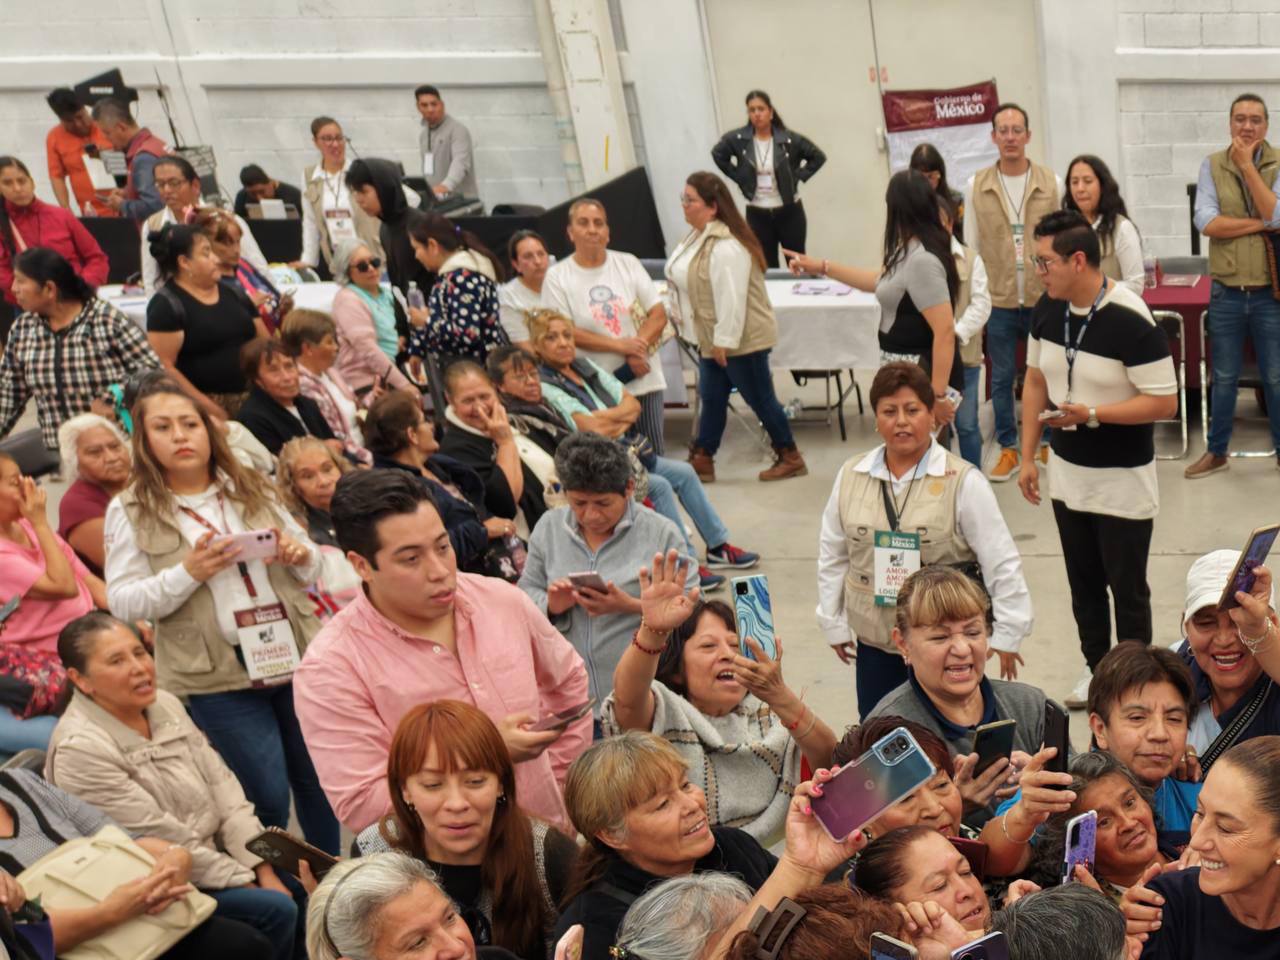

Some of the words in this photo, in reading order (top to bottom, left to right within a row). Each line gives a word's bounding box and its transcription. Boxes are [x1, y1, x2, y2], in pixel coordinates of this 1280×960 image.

[934, 95, 970, 105] Gobierno
[971, 93, 982, 101] de
[934, 102, 985, 119] México
